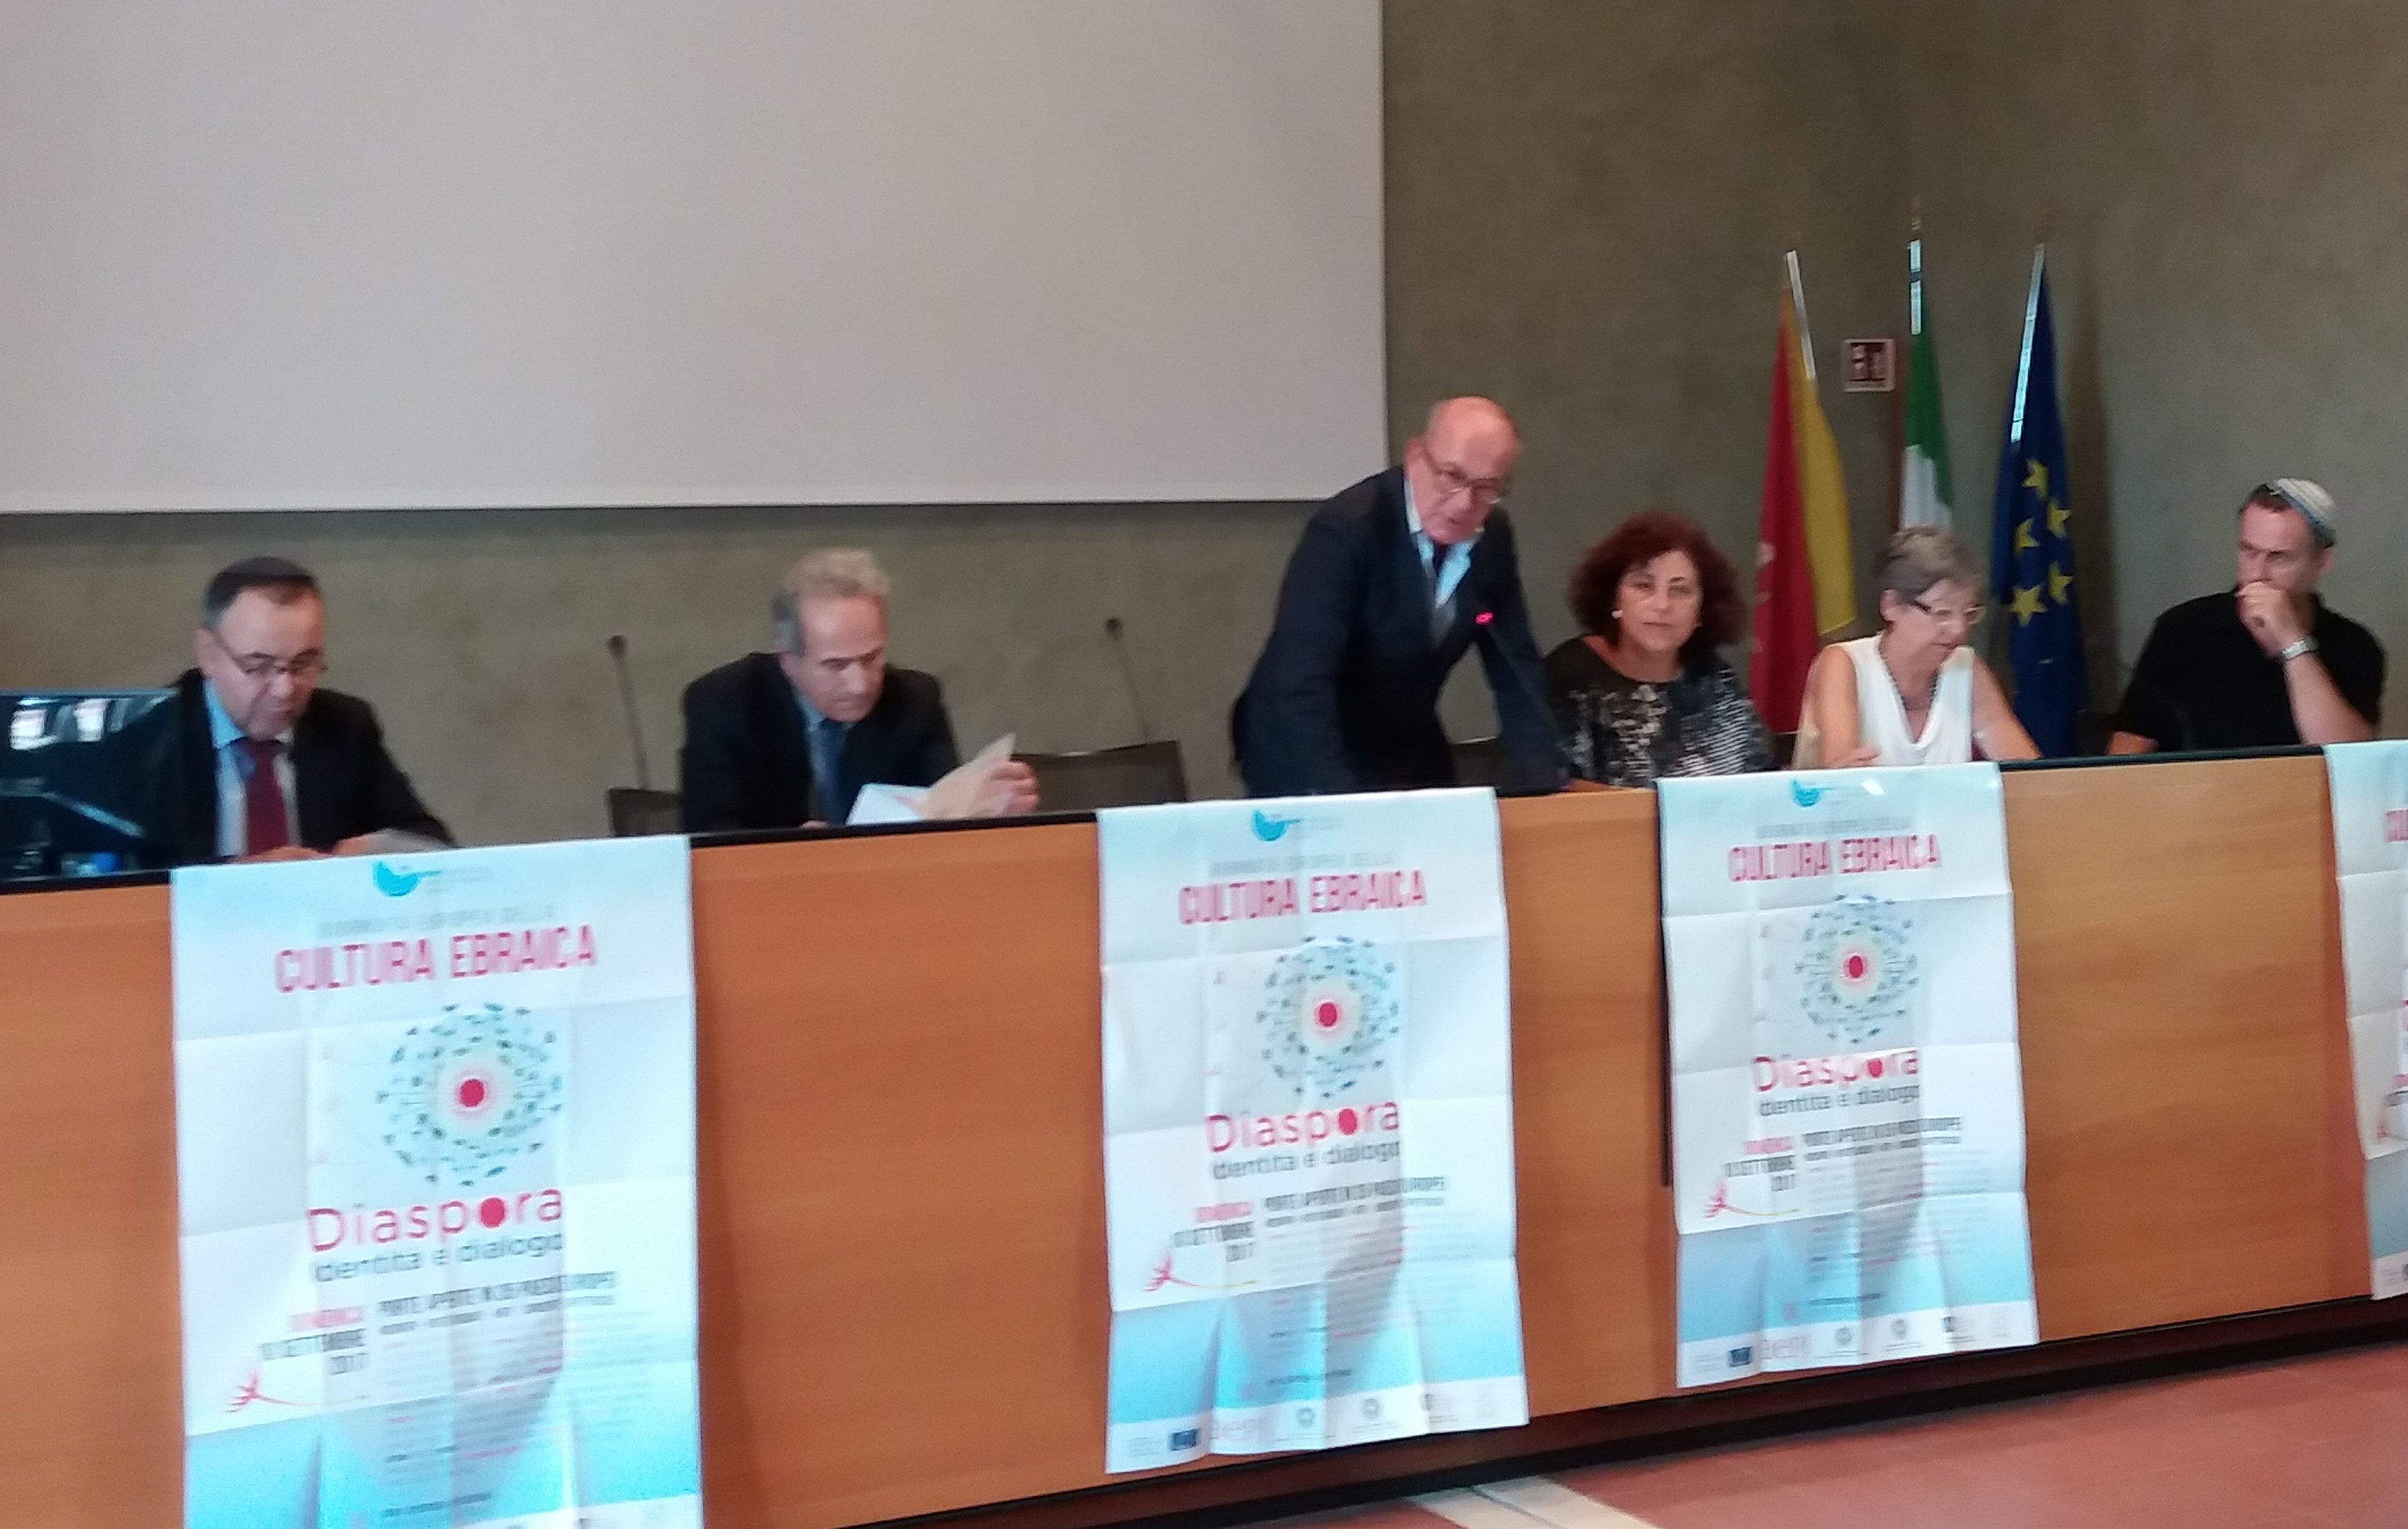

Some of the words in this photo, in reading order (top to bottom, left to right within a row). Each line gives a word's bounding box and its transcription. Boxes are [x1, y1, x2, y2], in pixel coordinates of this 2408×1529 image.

[1728, 840, 1831, 881] CULTURA
[1838, 834, 1942, 874] EBRAICA
[1179, 877, 1300, 924] CULTURA
[1309, 869, 1427, 914] EBRAICA
[275, 938, 436, 993] CULTURA
[450, 924, 597, 979] EBRAICA
[1753, 1050, 1918, 1092] Diaspora
[1205, 1102, 1399, 1152] Diaspora
[308, 1189, 562, 1252] Diaspora
